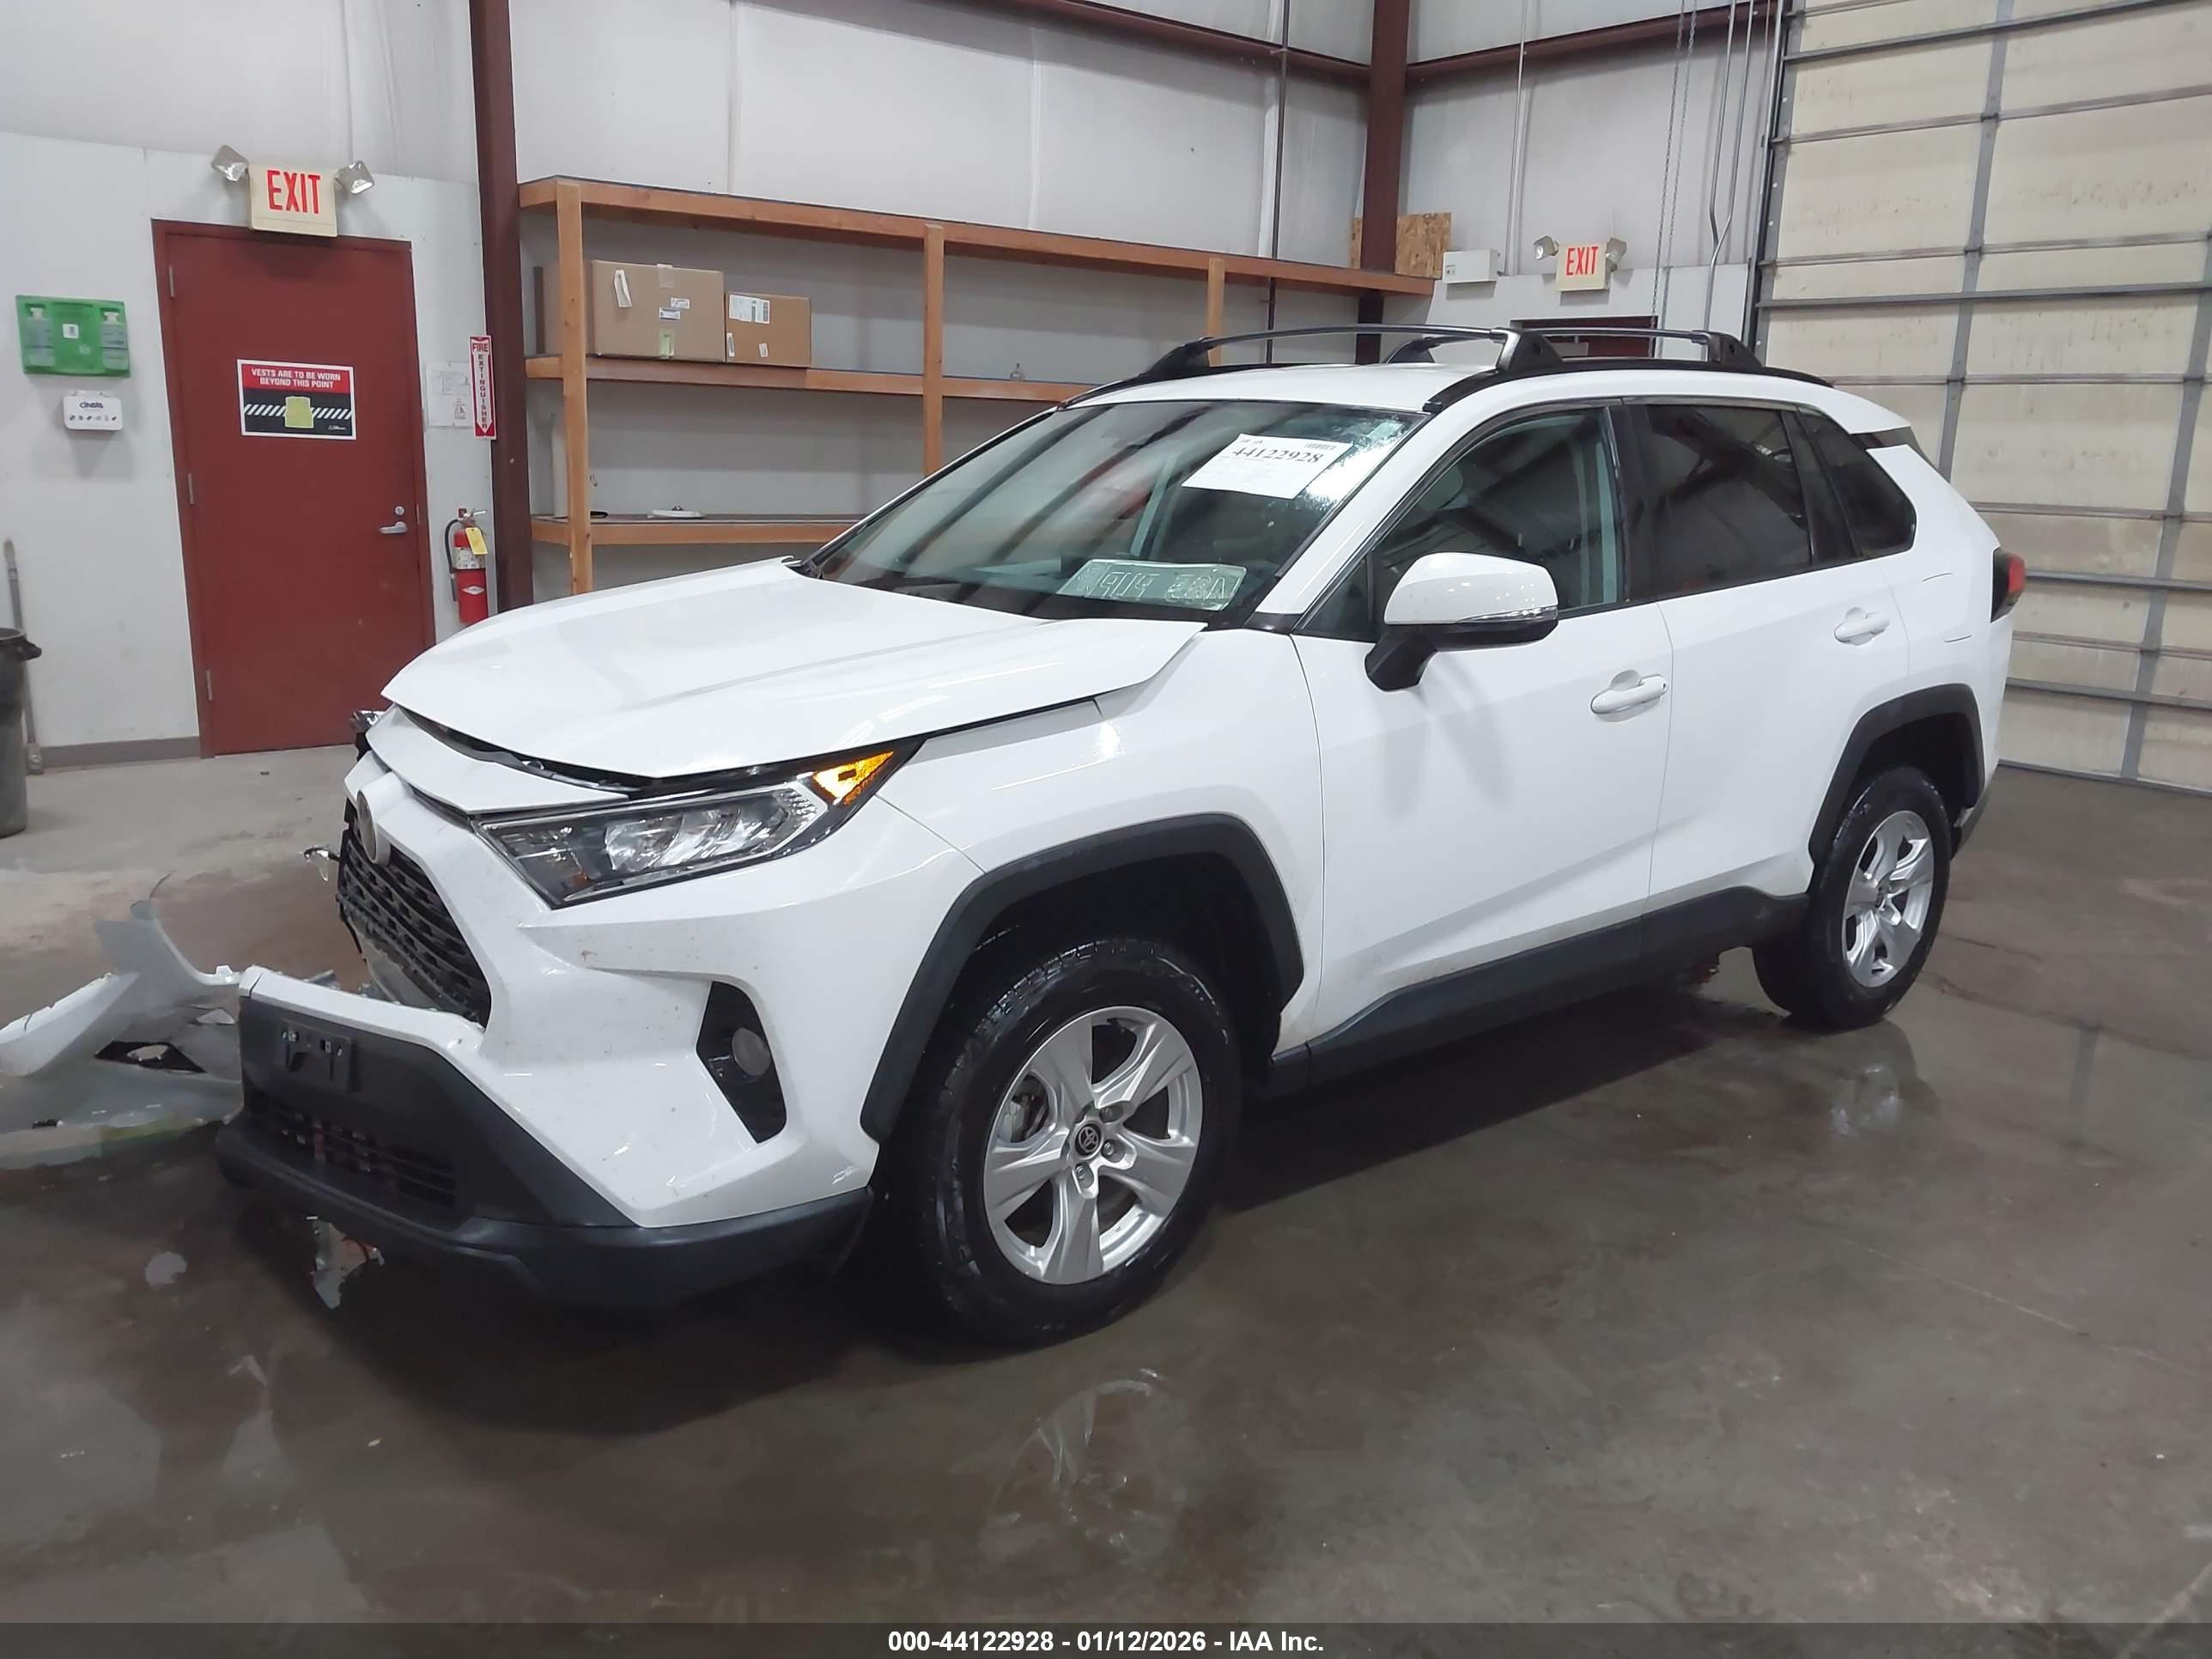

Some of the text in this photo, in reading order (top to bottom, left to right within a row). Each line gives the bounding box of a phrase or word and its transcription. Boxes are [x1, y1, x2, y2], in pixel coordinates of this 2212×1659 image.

[267, 170, 320, 215] EXIT
[1565, 246, 1598, 276] EXIT
[472, 343, 489, 352] FIRE
[252, 368, 276, 377] VESTS
[317, 372, 341, 381] WORN
[259, 377, 334, 389] BEYOND THIS POINT
[478, 354, 488, 428] EXTINGUISHER
[1232, 447, 1324, 464] 44122928
